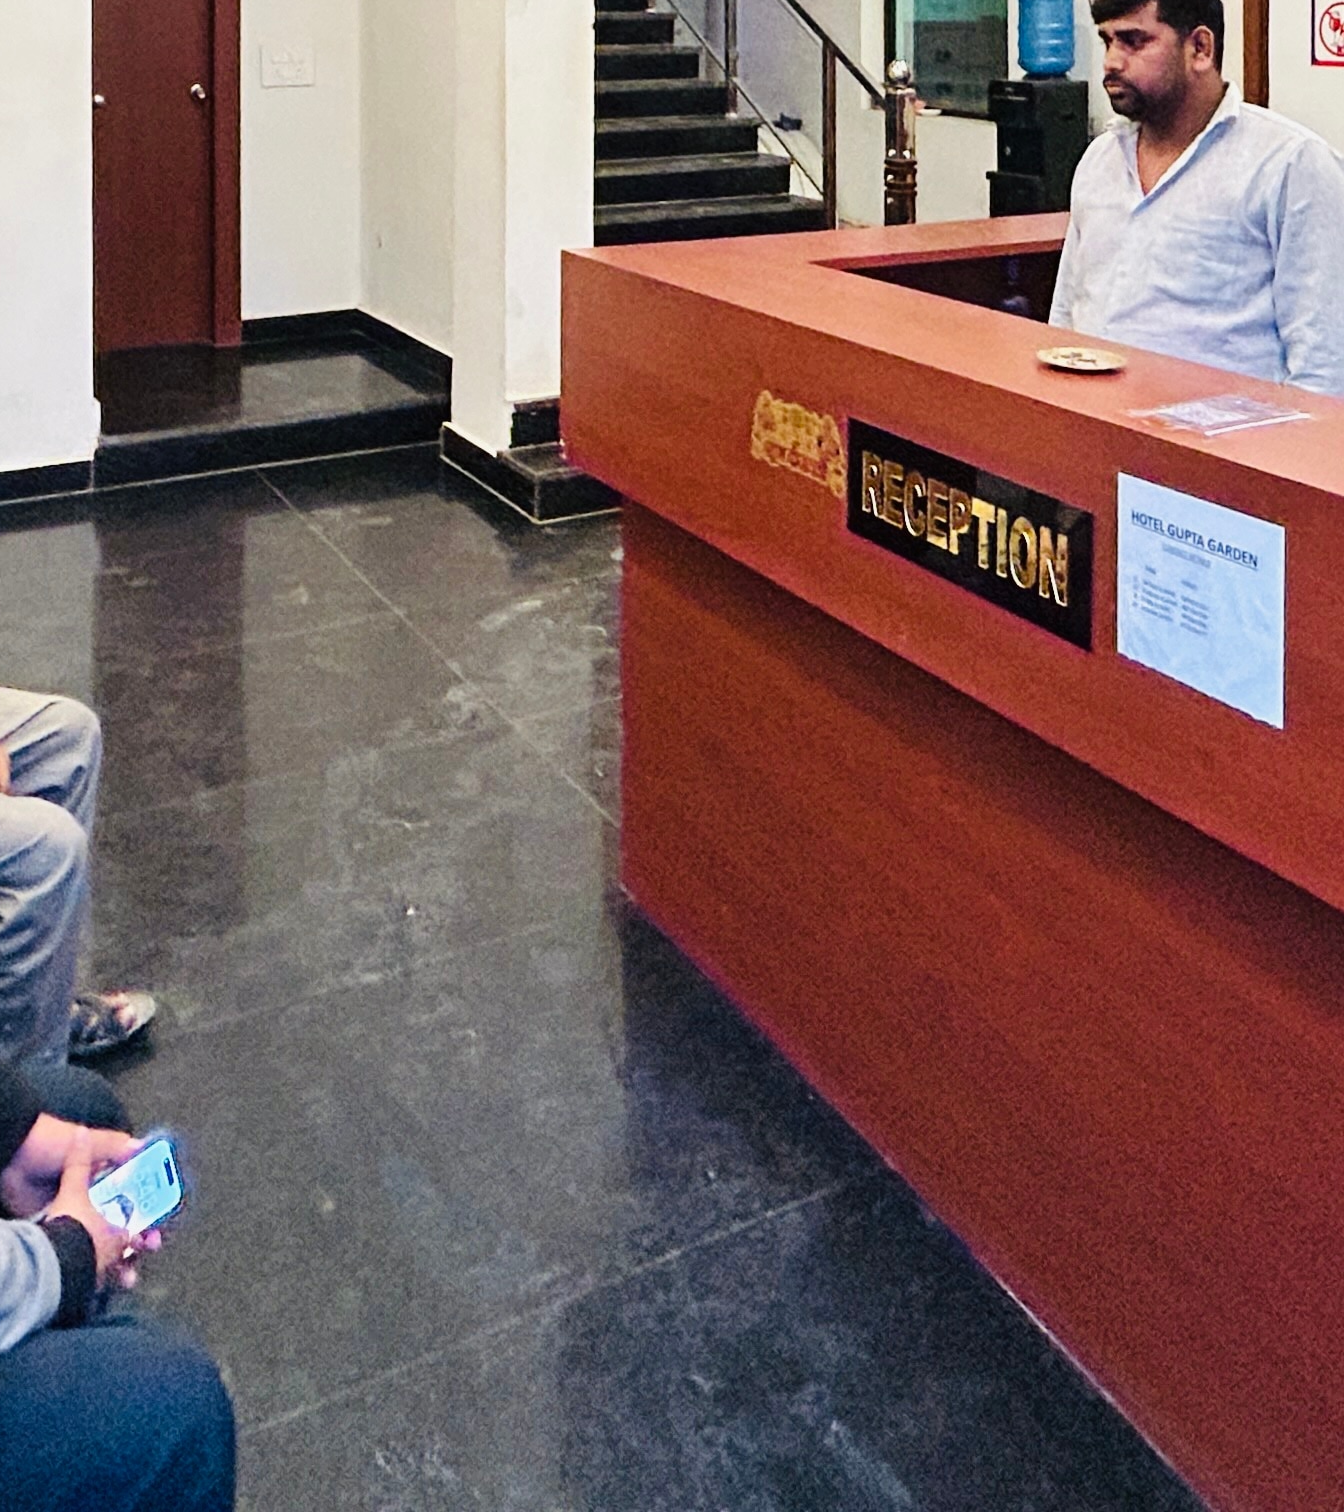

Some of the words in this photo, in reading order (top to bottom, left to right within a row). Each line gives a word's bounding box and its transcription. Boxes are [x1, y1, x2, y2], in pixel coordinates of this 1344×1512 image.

[862, 450, 1069, 607] RECEPTION
[1131, 509, 1166, 533] HOTEL
[1167, 523, 1205, 548] GUPTA
[1207, 538, 1259, 568] GARDEN
